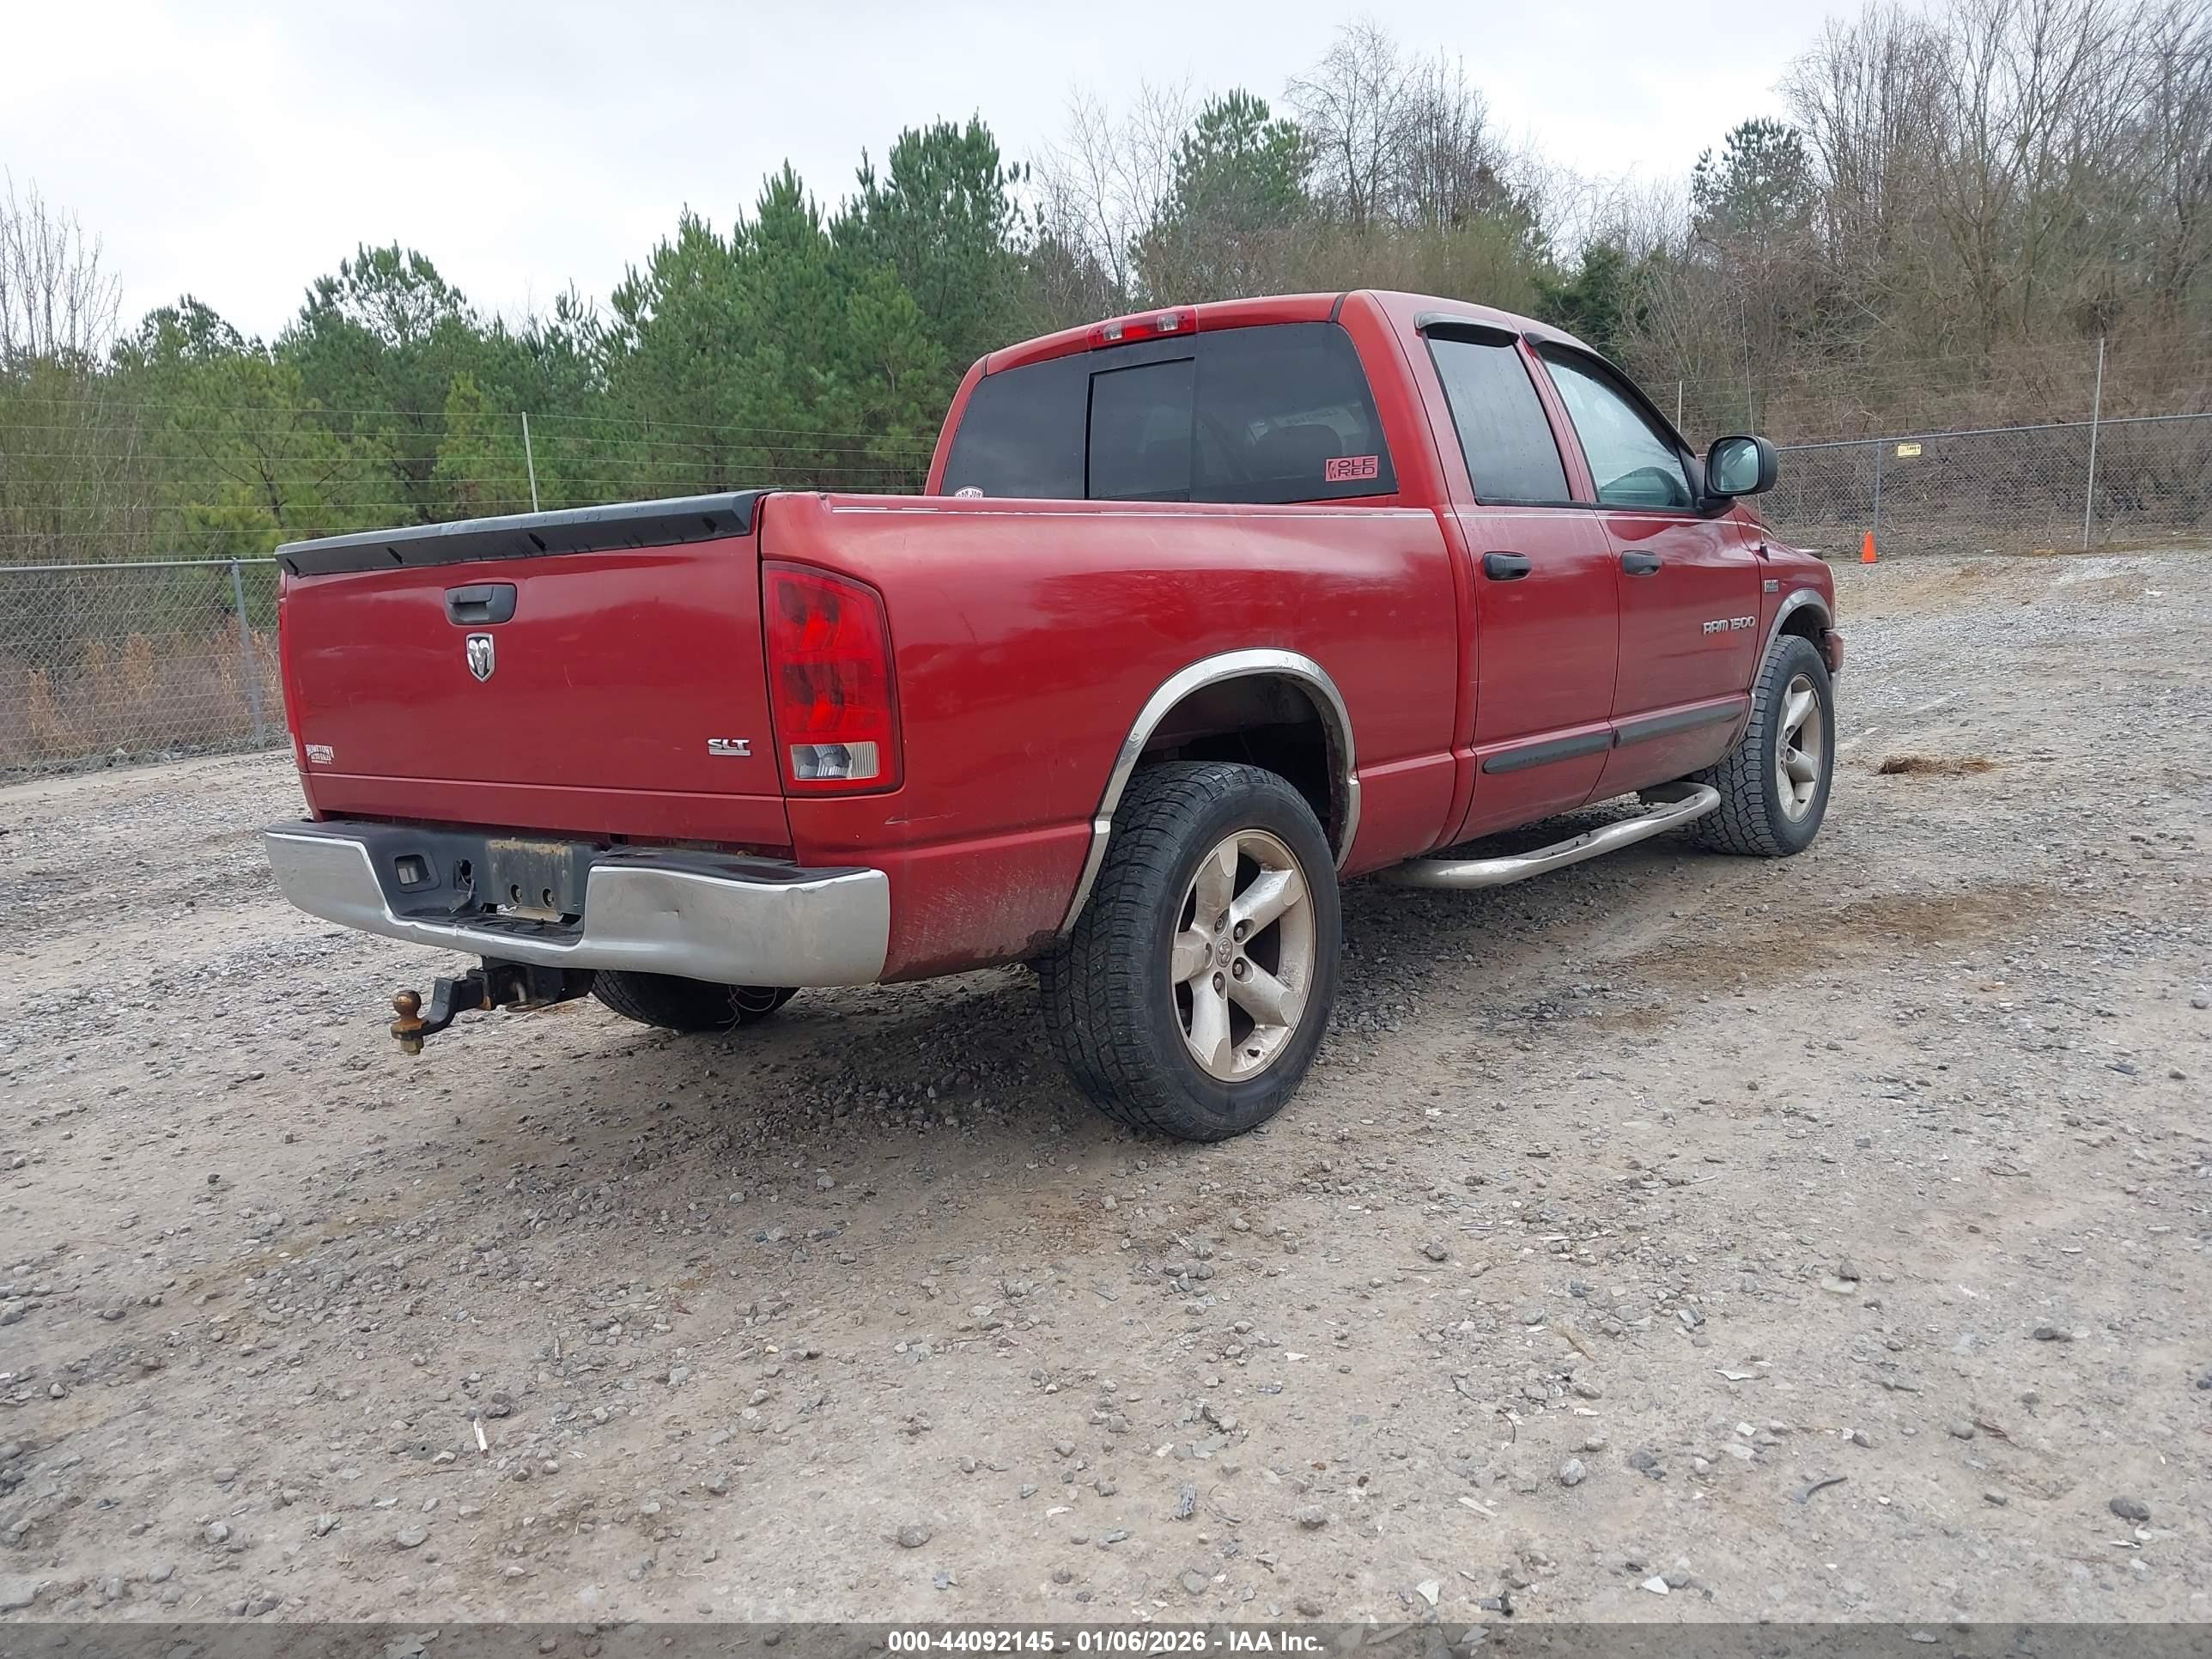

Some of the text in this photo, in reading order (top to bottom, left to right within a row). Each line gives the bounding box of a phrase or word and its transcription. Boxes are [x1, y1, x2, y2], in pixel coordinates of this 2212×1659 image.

[1338, 458, 1375, 468] OLE
[1338, 466, 1375, 477] RED
[1704, 616, 1755, 635] RAM 1500
[707, 738, 750, 750] SLT
